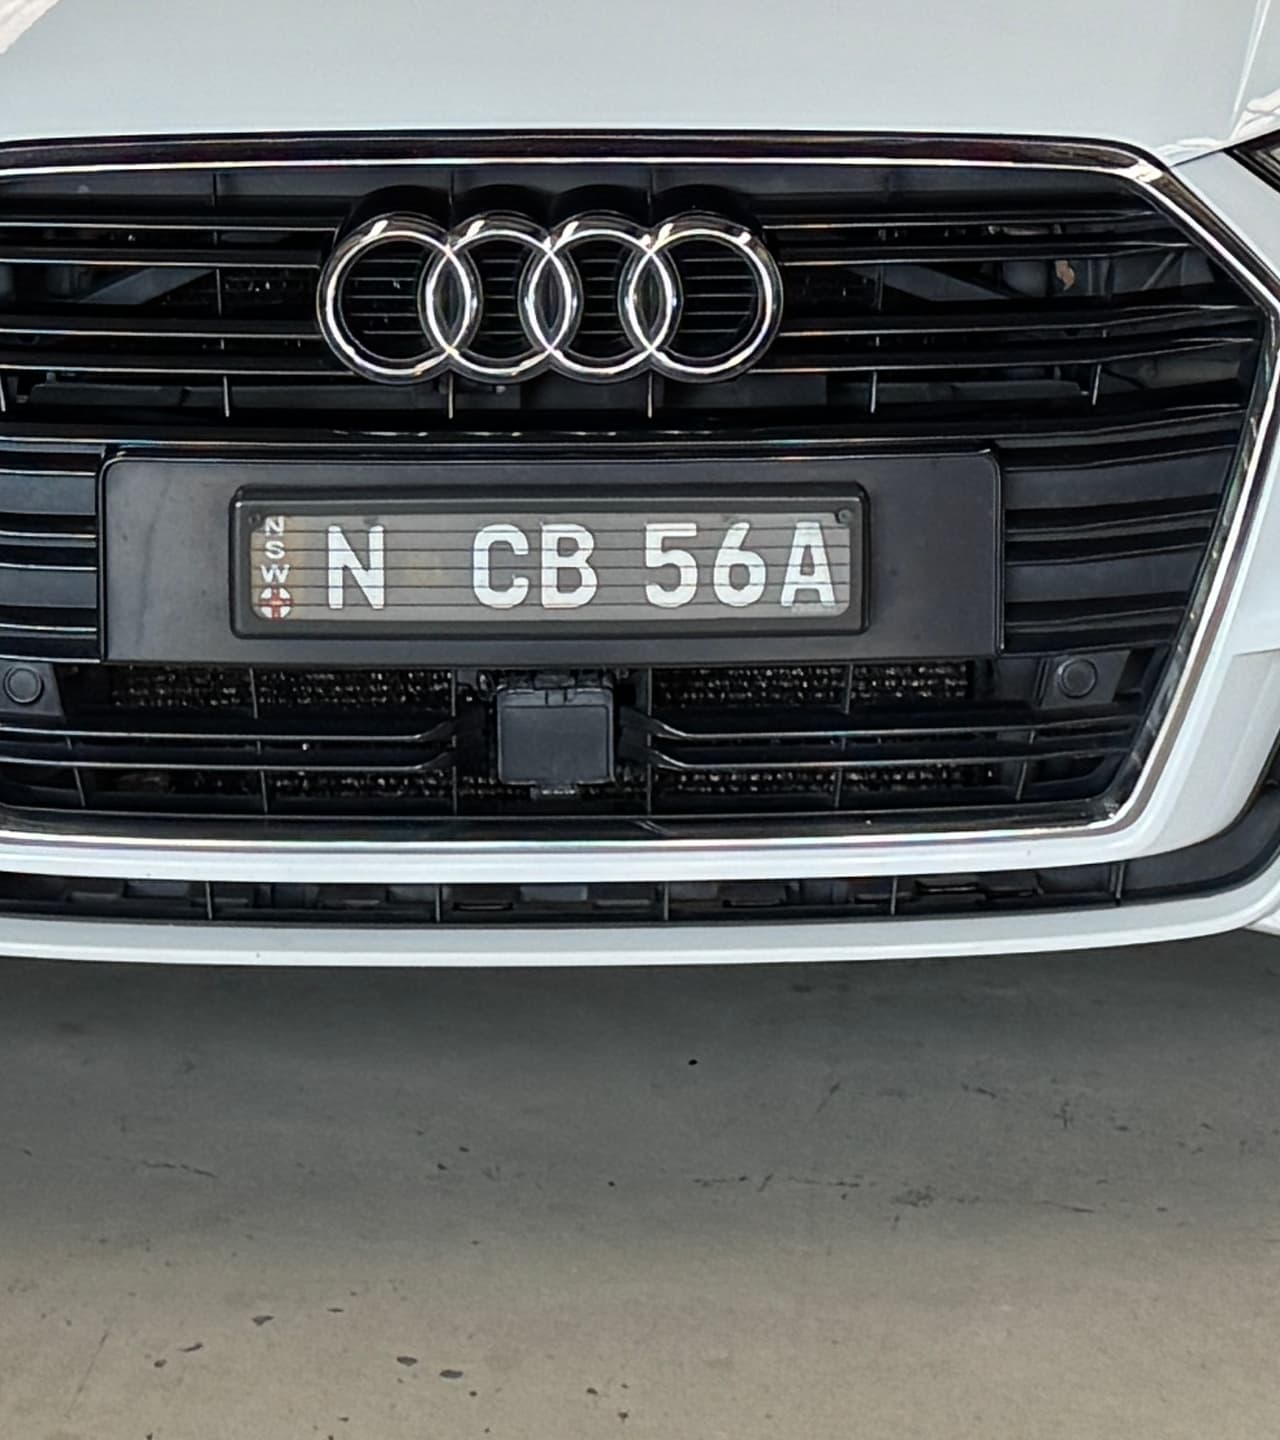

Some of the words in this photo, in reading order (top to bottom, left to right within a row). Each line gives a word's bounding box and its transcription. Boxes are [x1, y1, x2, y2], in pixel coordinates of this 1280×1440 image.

[327, 525, 385, 610] N
[472, 523, 598, 609] CB
[643, 521, 837, 608] 56A
